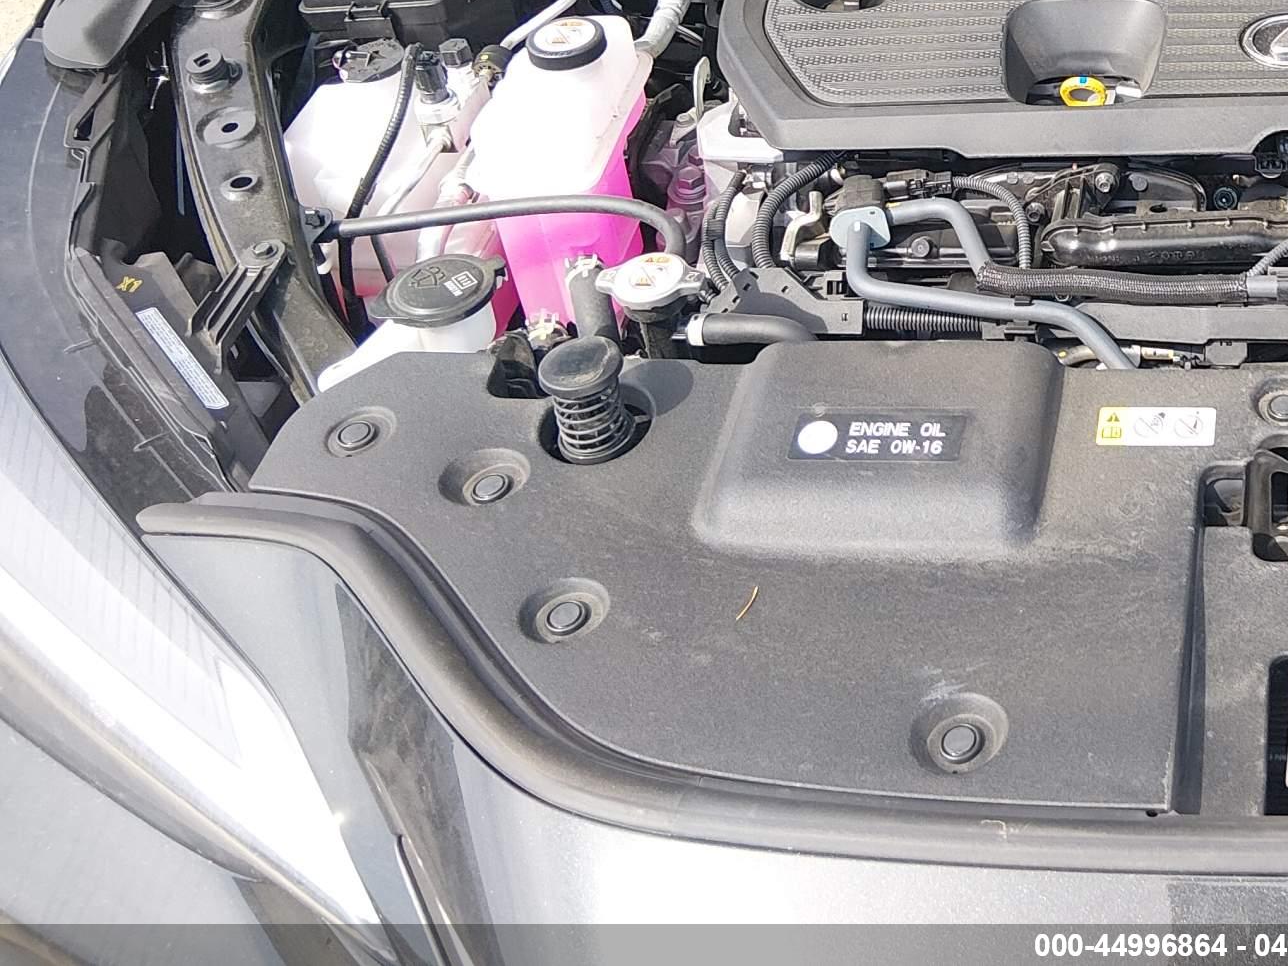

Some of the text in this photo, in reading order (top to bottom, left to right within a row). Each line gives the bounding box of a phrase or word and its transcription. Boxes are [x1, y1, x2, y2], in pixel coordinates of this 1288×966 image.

[115, 275, 144, 293] X1
[849, 421, 946, 436] ENGINE OIL
[845, 439, 943, 454] SAE 0W-16
